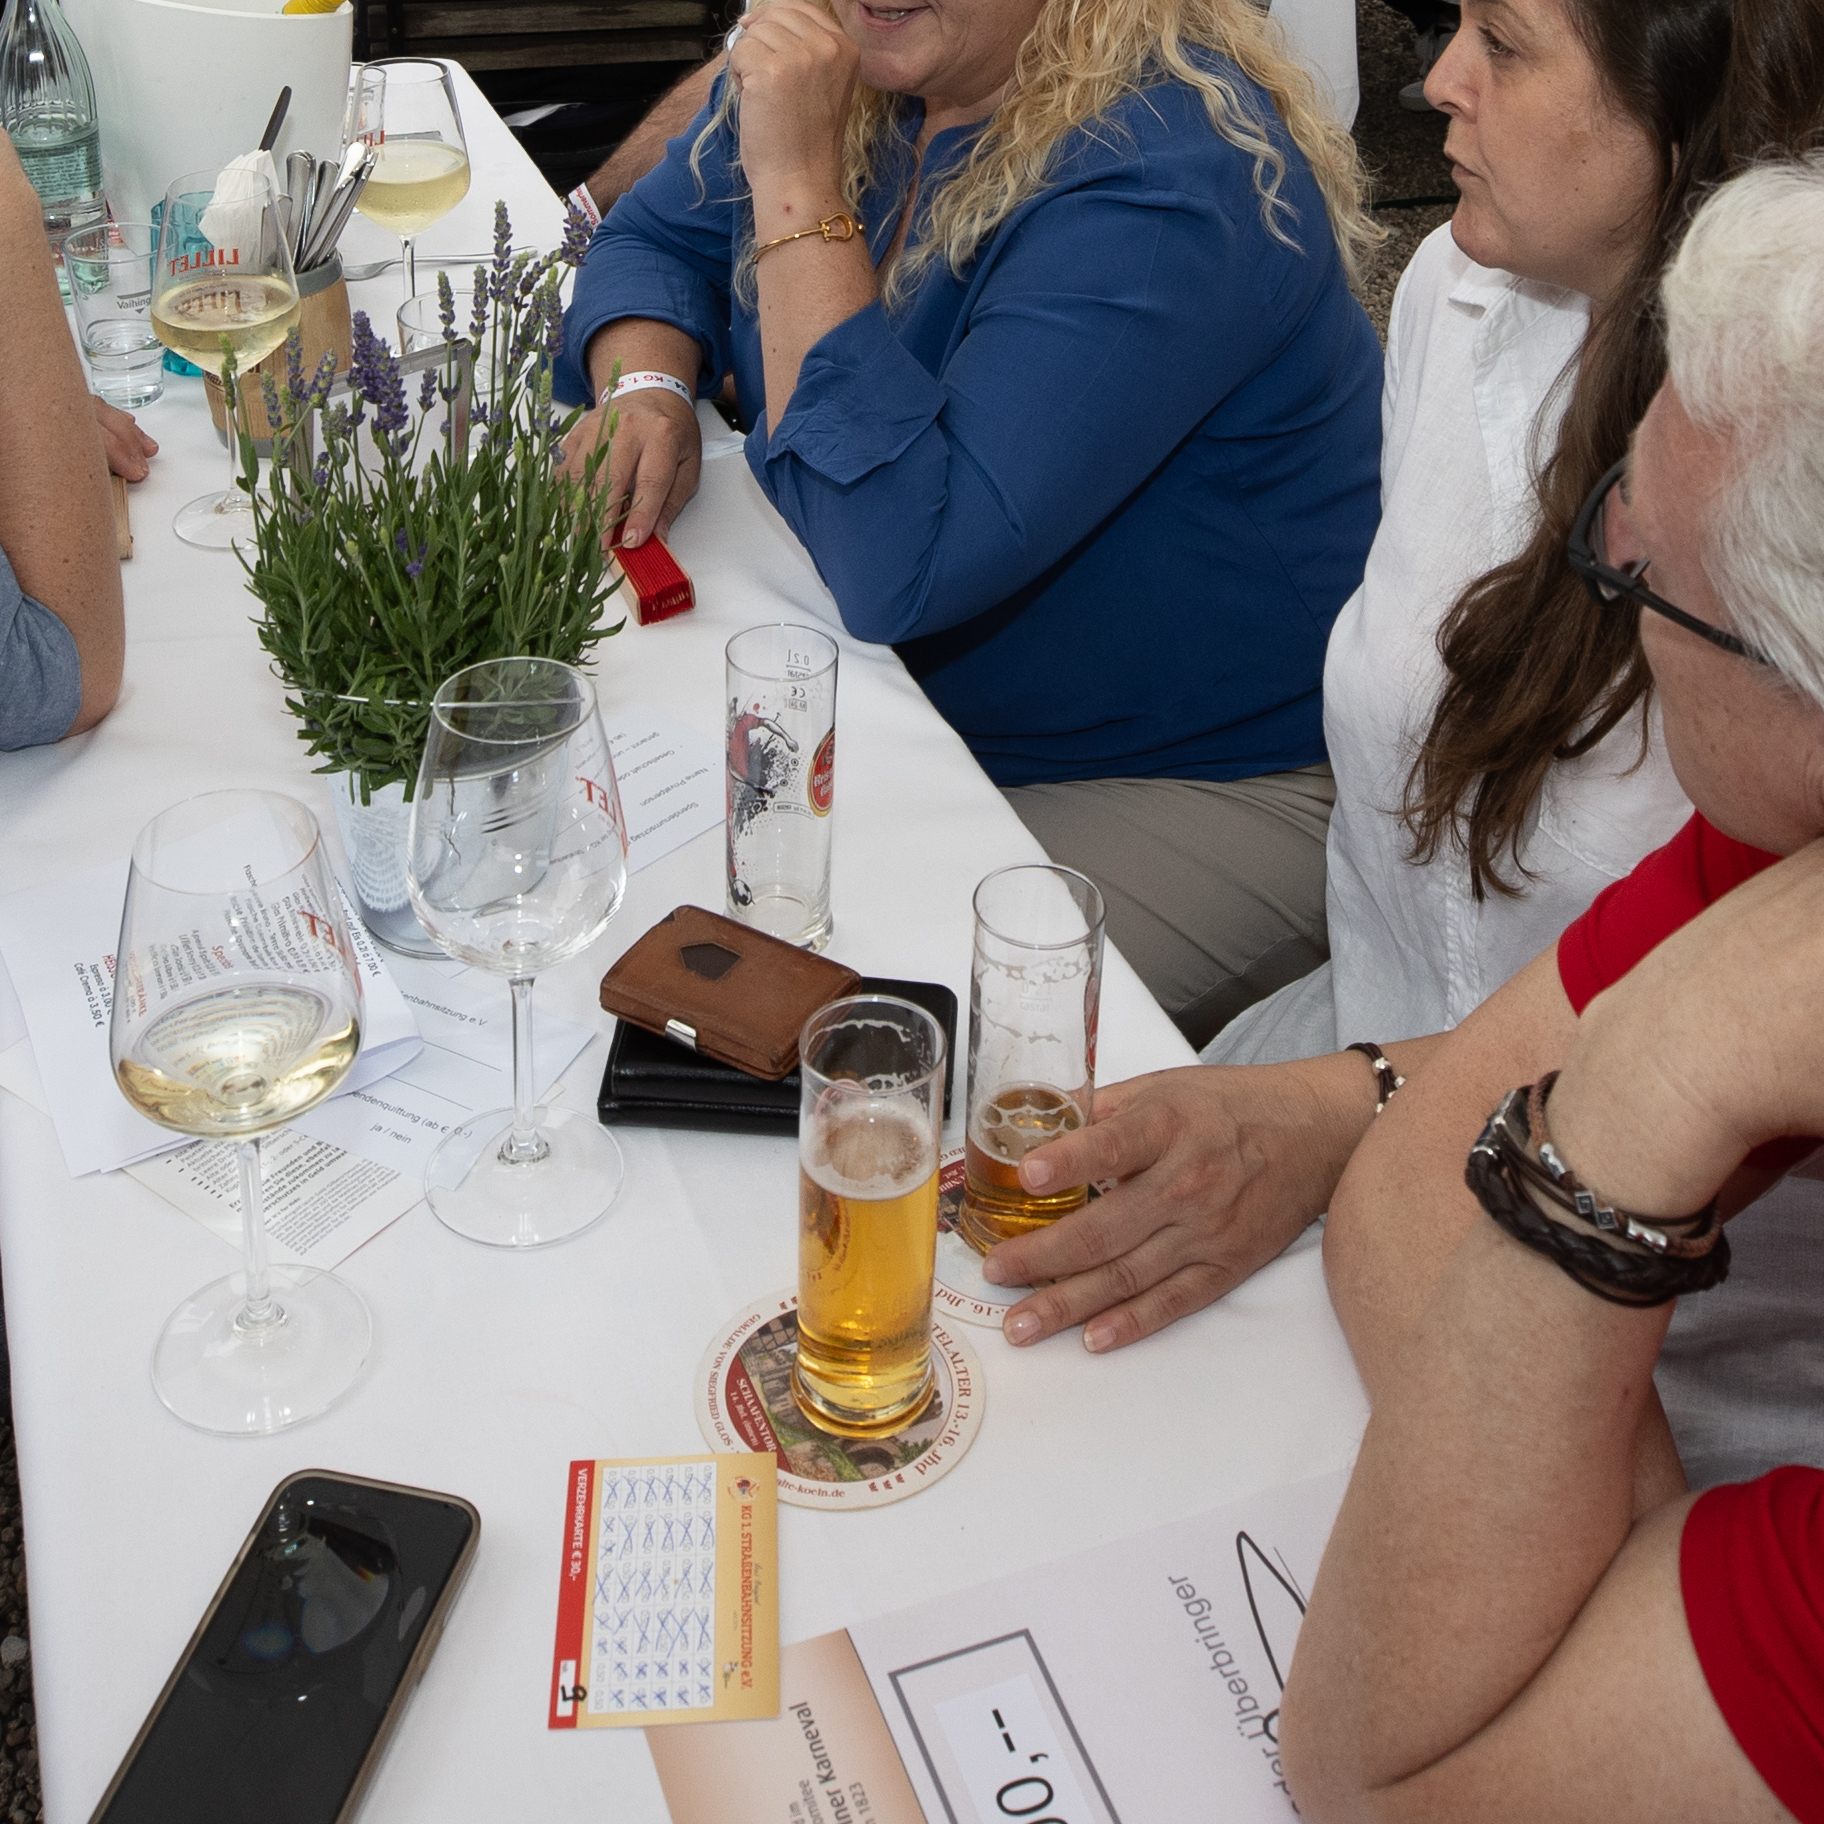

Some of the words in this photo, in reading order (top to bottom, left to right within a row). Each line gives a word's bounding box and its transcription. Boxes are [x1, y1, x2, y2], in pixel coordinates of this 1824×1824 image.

[116, 295, 152, 310] Vaihing
[684, 767, 709, 781] Name
[639, 778, 687, 807] Privatperson
[629, 801, 699, 843] Spendenumschlag
[89, 1002, 102, 1020] 3,50
[400, 989, 469, 1023] enbahnsitzung
[351, 1090, 422, 1124] endenquittung
[369, 1123, 383, 1134] ja
[390, 1130, 413, 1145] nein
[268, 1154, 304, 1181] Freunden
[725, 1313, 761, 1353] GEMÄLDE
[714, 1349, 729, 1370] VON
[931, 1322, 973, 1399] TELALTER
[706, 1369, 721, 1422] SIEGFRIED
[736, 1378, 777, 1454] SCHAAFENTOR
[714, 1419, 735, 1448] GLOS
[776, 1477, 846, 1499] alte-koeln.de
[573, 1468, 588, 1552] VERZEHRKARTE
[741, 1503, 753, 1519] KG
[741, 1520, 752, 1530] 1.
[1168, 1575, 1267, 1741] Überbringer
[740, 1668, 753, 1689] e.V.
[788, 1701, 837, 1786] Karneval
[848, 1781, 872, 1816] 1823
